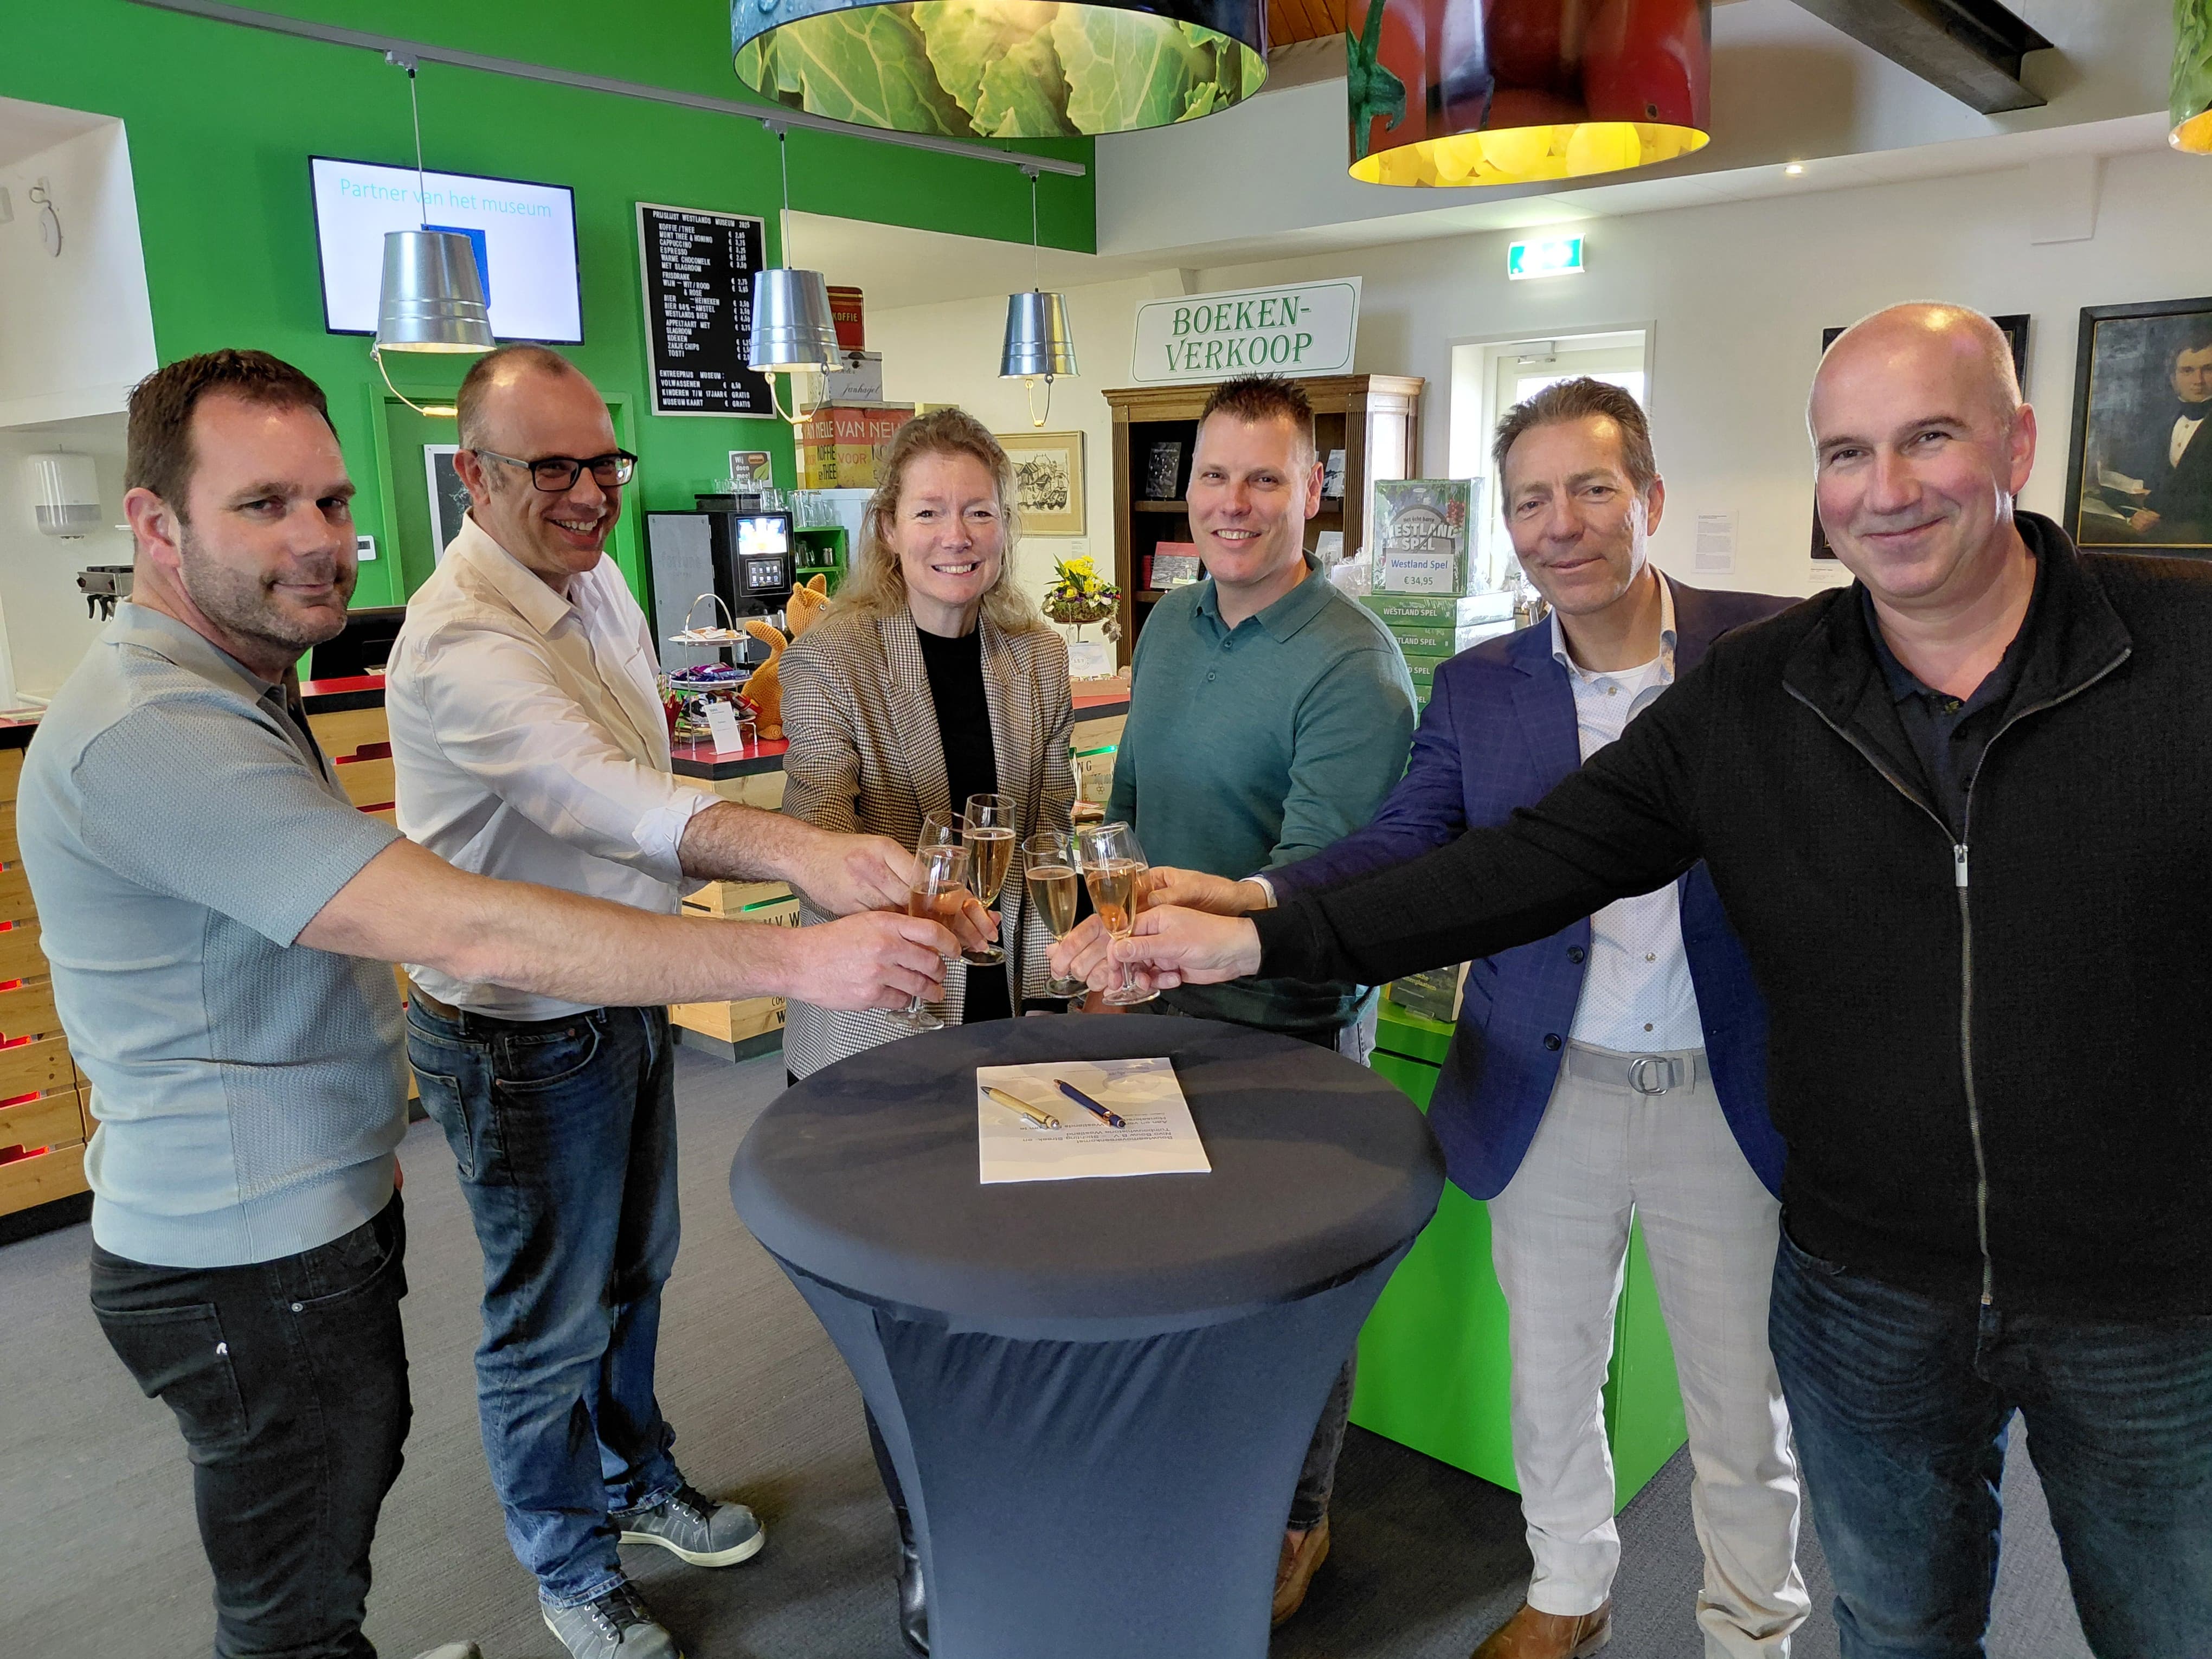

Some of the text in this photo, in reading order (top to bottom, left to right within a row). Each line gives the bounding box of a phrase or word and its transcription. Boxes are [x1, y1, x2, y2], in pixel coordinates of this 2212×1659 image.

[340, 178, 551, 217] Partner van het museum
[682, 214, 711, 224] WESTLANDS
[715, 218, 735, 227] MUSEUM
[660, 239, 692, 249] CAPPUCCINO
[694, 235, 713, 243] HONING
[660, 246, 687, 255] ESPRESSO
[661, 254, 679, 262] WARME
[681, 256, 711, 266] CHOCOMELK
[674, 263, 702, 272] SLAGROOM
[663, 271, 690, 280] FRISDRANK
[663, 279, 676, 287] WIJN
[665, 310, 695, 319] WESTLANDS
[832, 312, 858, 322] KOFFIE
[1172, 295, 1311, 337] BOEKEN-
[666, 319, 697, 328] APPELTAART
[700, 321, 710, 330] MET
[666, 327, 692, 335] SLAGROOM
[667, 335, 687, 343] KOEKEN
[684, 343, 699, 351] CHIPS
[1165, 332, 1313, 372] VERKOOP
[660, 370, 693, 378] ENTREEPRIJS
[661, 380, 700, 388] VOLWASSENEN
[662, 389, 689, 397] KINDEREN
[815, 421, 834, 439] NELLE
[835, 421, 865, 438] VAN
[817, 445, 835, 461] KOFFIE
[735, 456, 744, 465] Wij
[838, 453, 866, 465] VOOR
[822, 464, 837, 480] THEE
[1401, 537, 1435, 551] SPEL
[1391, 559, 1448, 570] Westland Spel
[1384, 608, 1419, 616] WESTLAND
